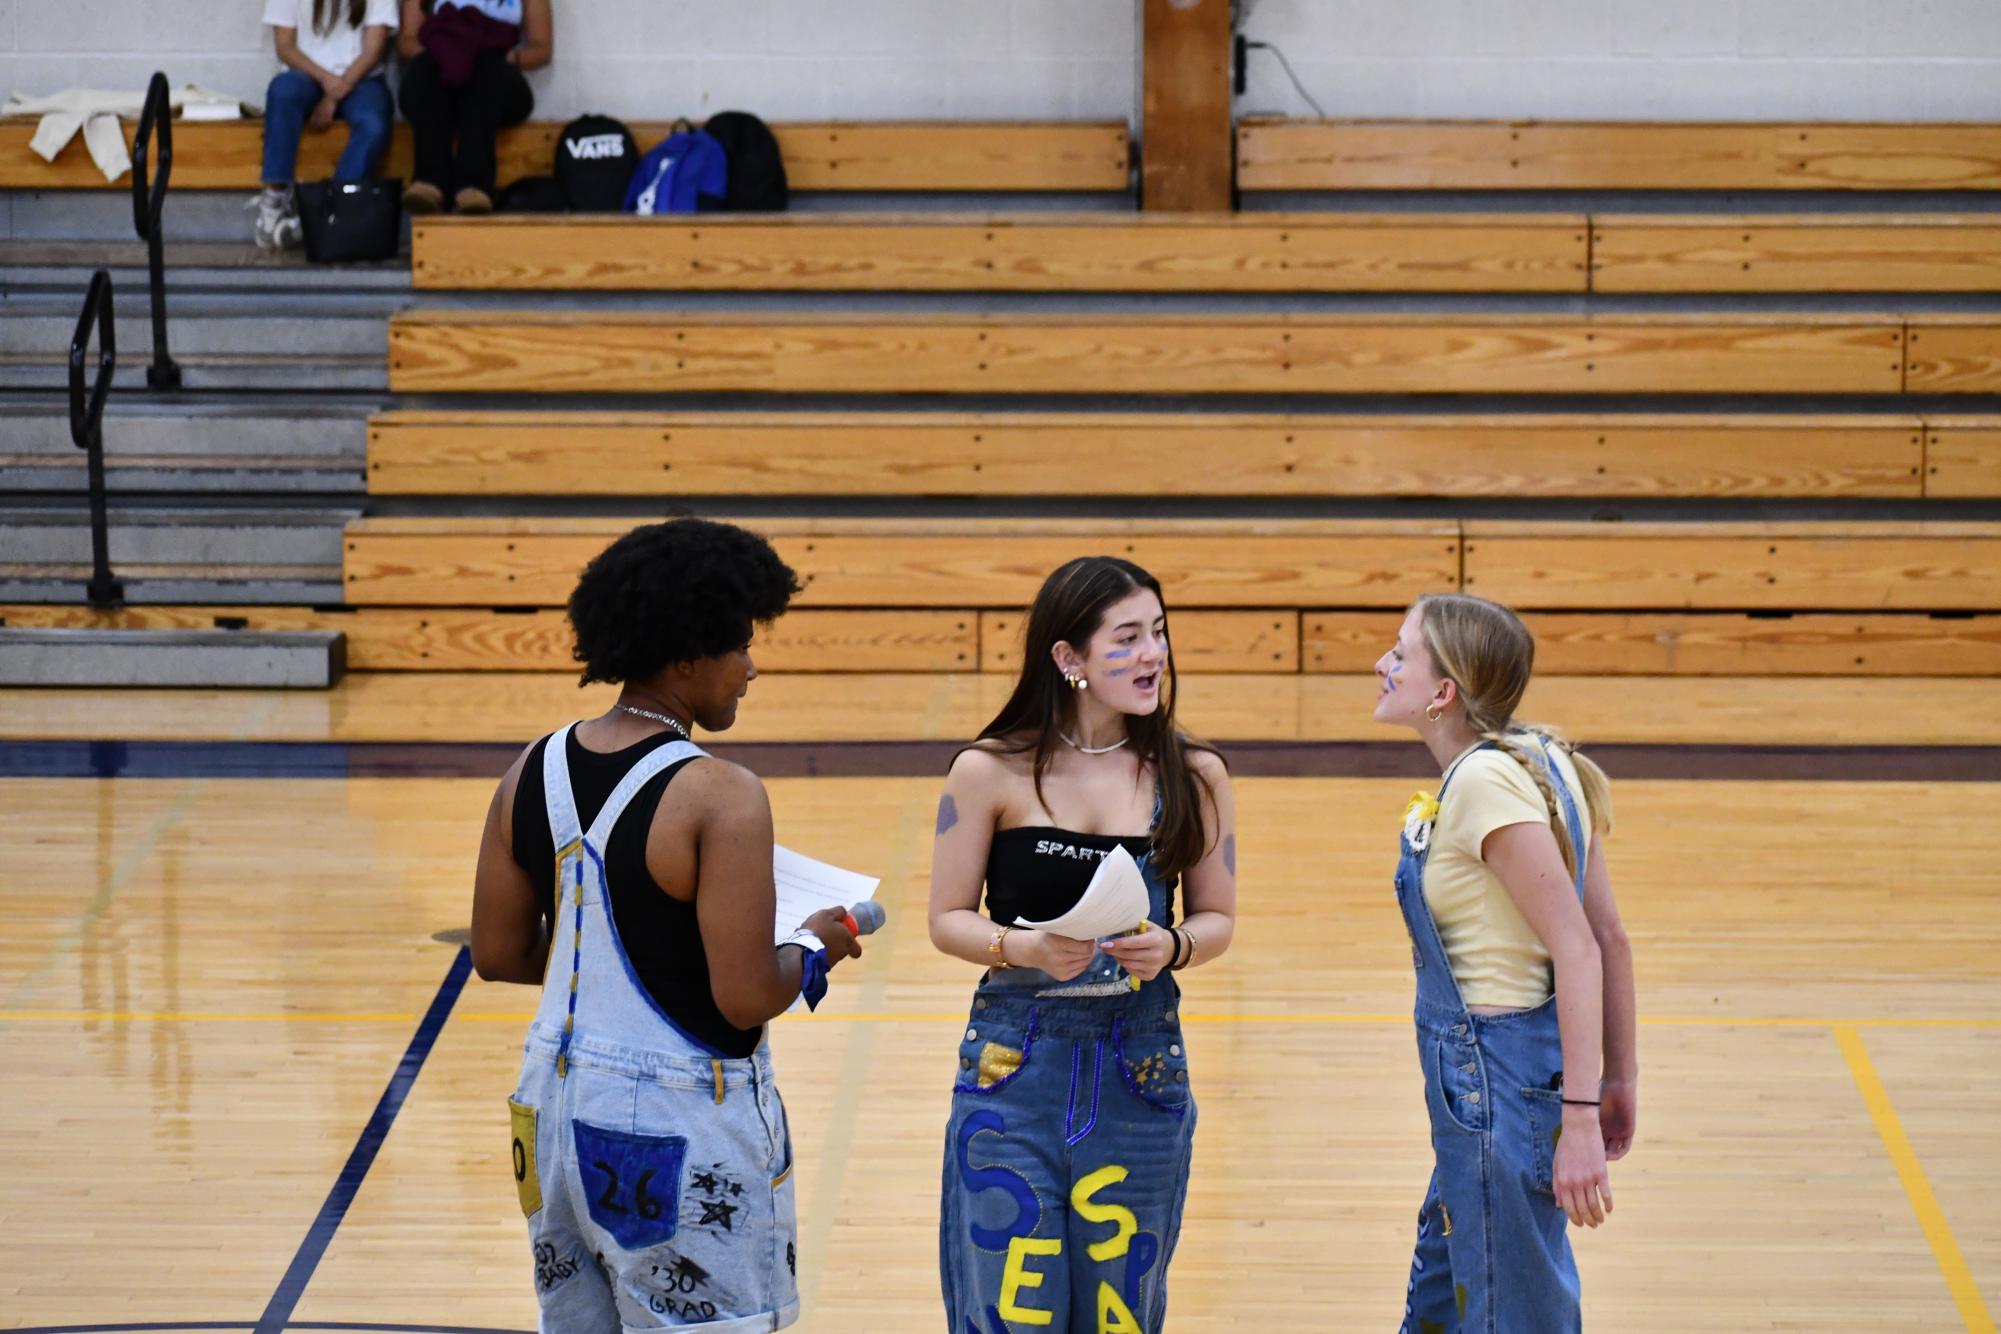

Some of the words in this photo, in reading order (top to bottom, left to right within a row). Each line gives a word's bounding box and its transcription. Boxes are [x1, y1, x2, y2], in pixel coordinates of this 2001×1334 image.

[566, 133, 625, 160] VANS
[593, 1160, 663, 1220] 26
[649, 1293, 718, 1320] GRAD
